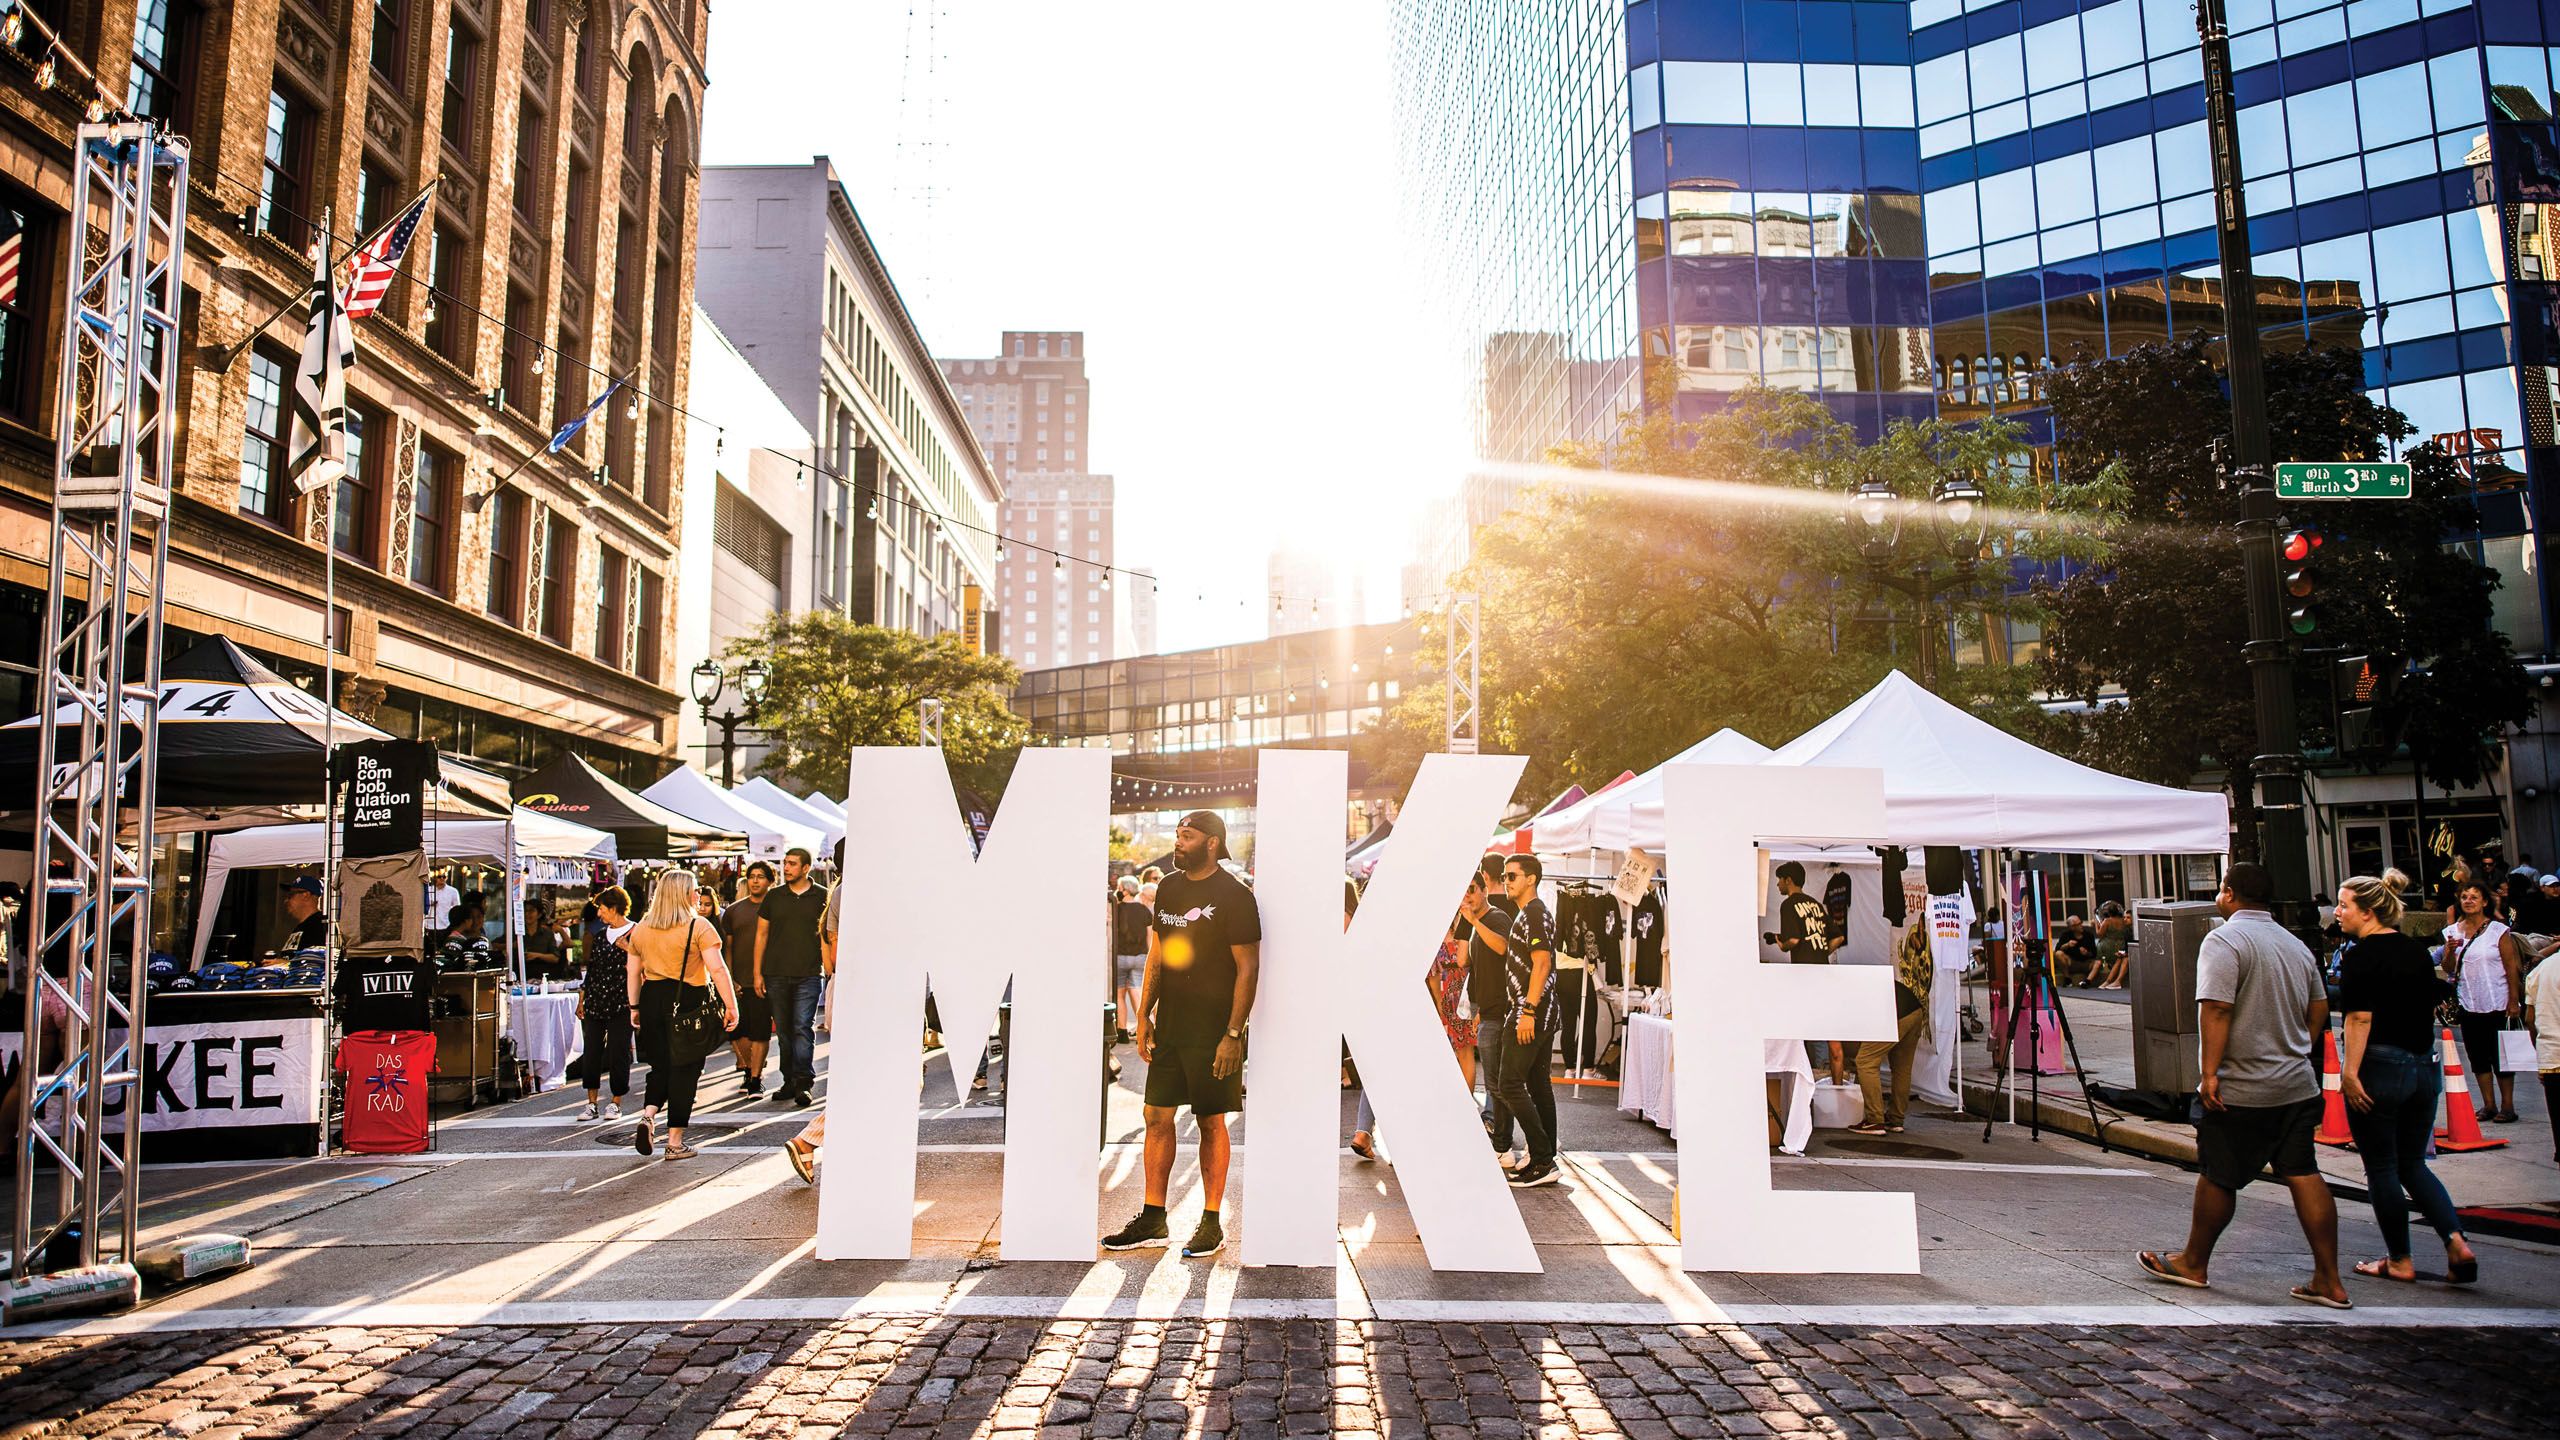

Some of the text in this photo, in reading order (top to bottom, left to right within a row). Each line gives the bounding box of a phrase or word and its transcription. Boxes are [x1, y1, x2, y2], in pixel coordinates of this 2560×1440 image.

[2282, 474, 2293, 487] N
[2306, 468, 2330, 480] Old
[2389, 474, 2405, 486] St
[2302, 481, 2340, 493] World
[966, 608, 977, 644] HERE
[358, 756, 378, 770] Re
[357, 768, 392, 780] com
[356, 781, 386, 794] bob
[355, 792, 411, 808] ulation
[354, 807, 392, 821] Area
[376, 1053, 402, 1069] DAS
[367, 1093, 404, 1112] RAD
